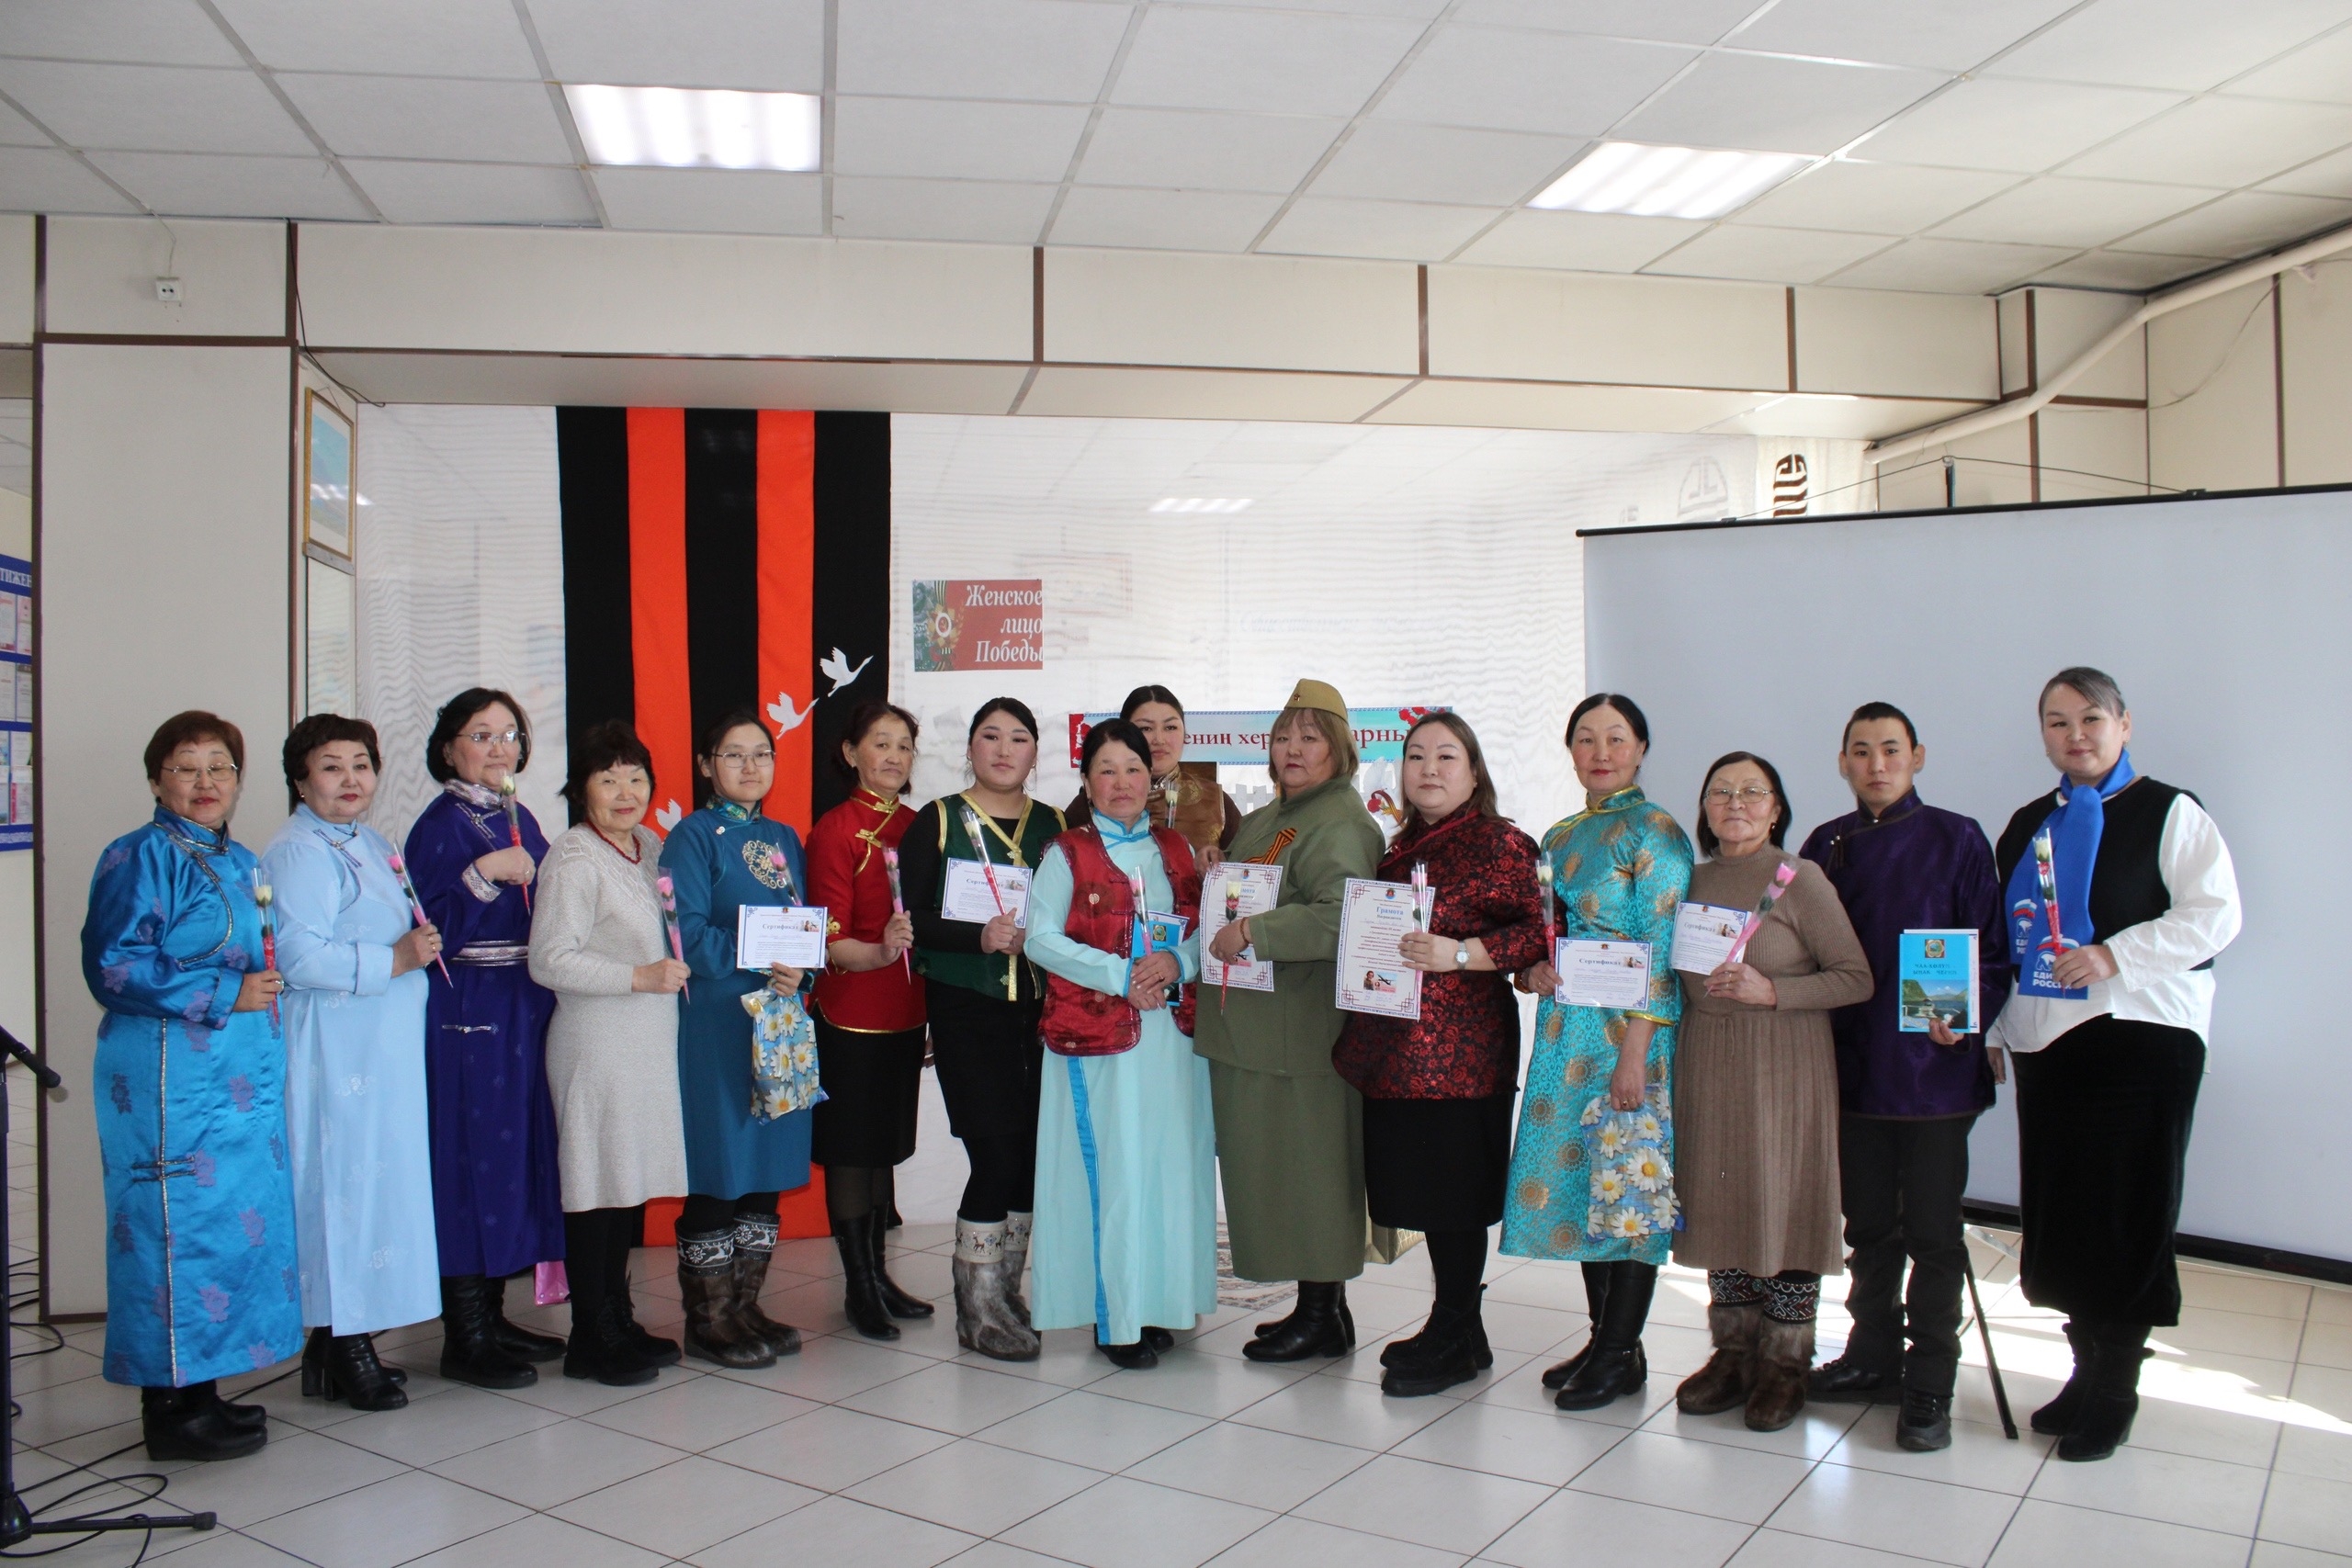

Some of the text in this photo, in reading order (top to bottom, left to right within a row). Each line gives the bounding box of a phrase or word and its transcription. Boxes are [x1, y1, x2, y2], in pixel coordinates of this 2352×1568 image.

[965, 584, 1042, 606] Женское
[1000, 617, 1043, 639] лицо
[975, 638, 1043, 662] Победы
[1376, 906, 1404, 916] Грамота
[1684, 922, 1715, 932] Сертификат
